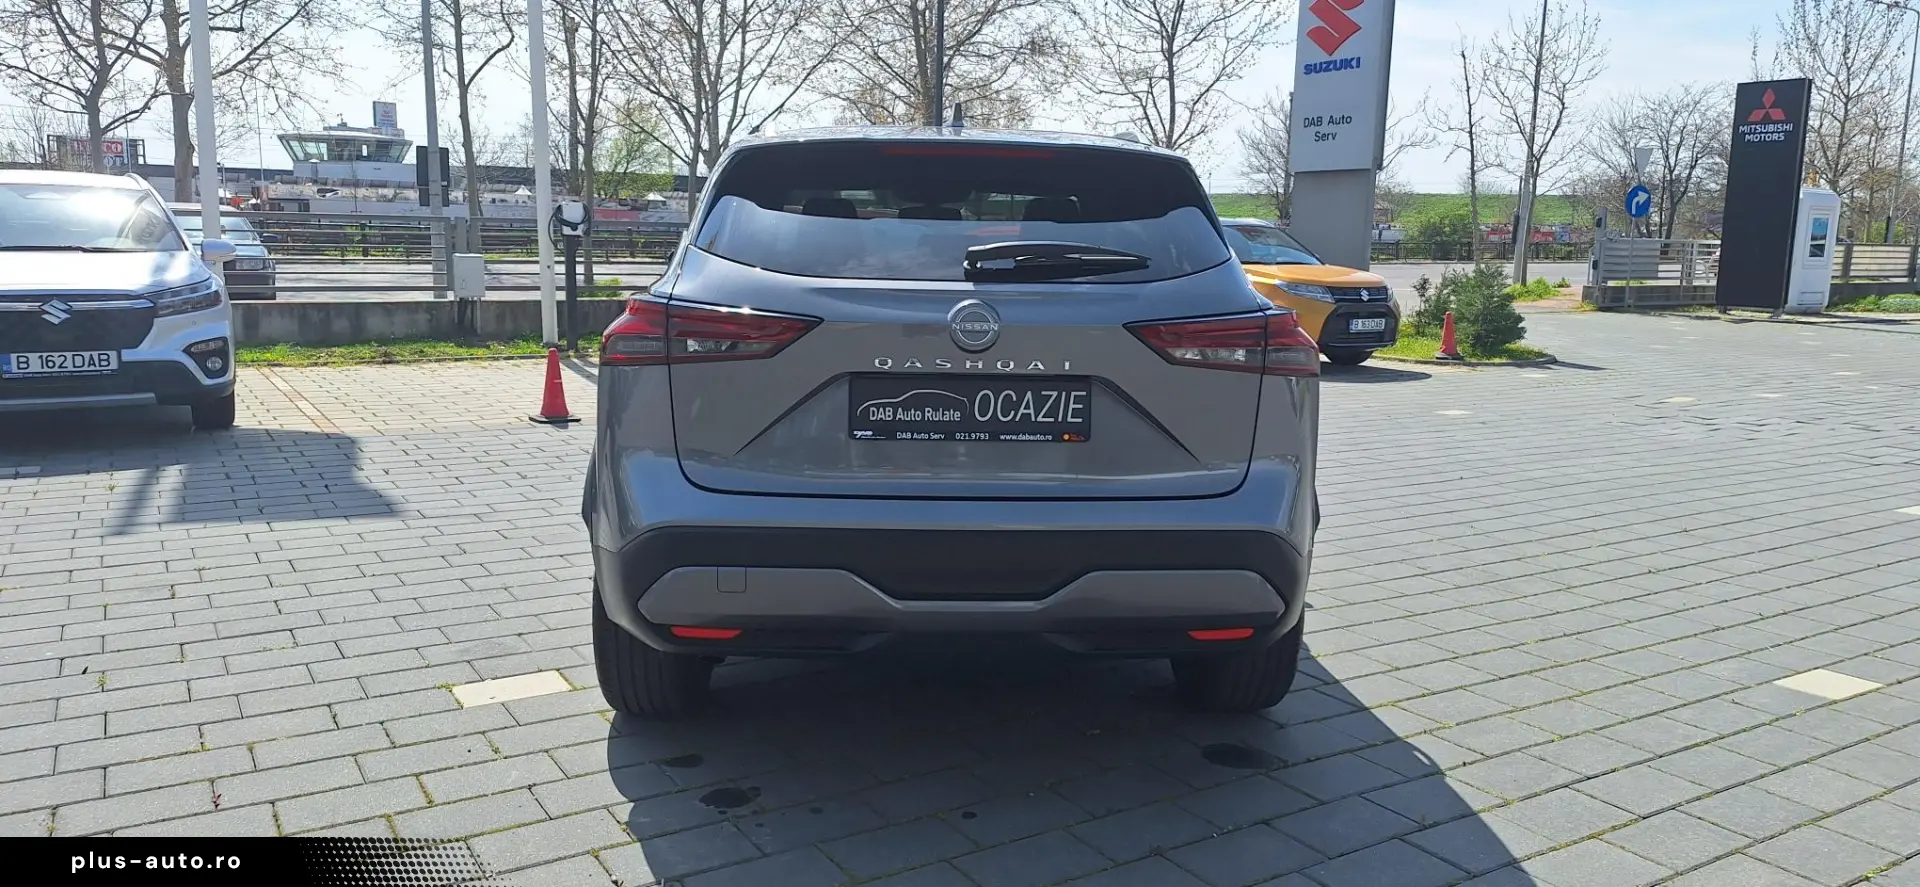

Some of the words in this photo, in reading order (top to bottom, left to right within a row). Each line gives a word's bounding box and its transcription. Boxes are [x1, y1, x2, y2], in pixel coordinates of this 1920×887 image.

[1303, 56, 1361, 76] SUZUKI
[1303, 116, 1323, 128] DAB
[1327, 114, 1352, 126] Auto
[1739, 123, 1793, 133] MITSUBISHI
[1314, 130, 1337, 142] Serv
[1744, 133, 1785, 142] MOTORS
[952, 323, 998, 331] NISSAN
[16, 355, 30, 370] B
[38, 354, 68, 370] 162
[71, 353, 111, 369] DAB
[874, 357, 1070, 372] QASHQAI
[974, 389, 1087, 422] OCAZIE
[869, 407, 893, 421] DAB
[896, 407, 922, 421] Auto
[925, 407, 961, 421] Rulate
[930, 432, 945, 440] Serv
[955, 432, 989, 440] 021.9793
[999, 432, 1052, 441] www.dabauto.ro
